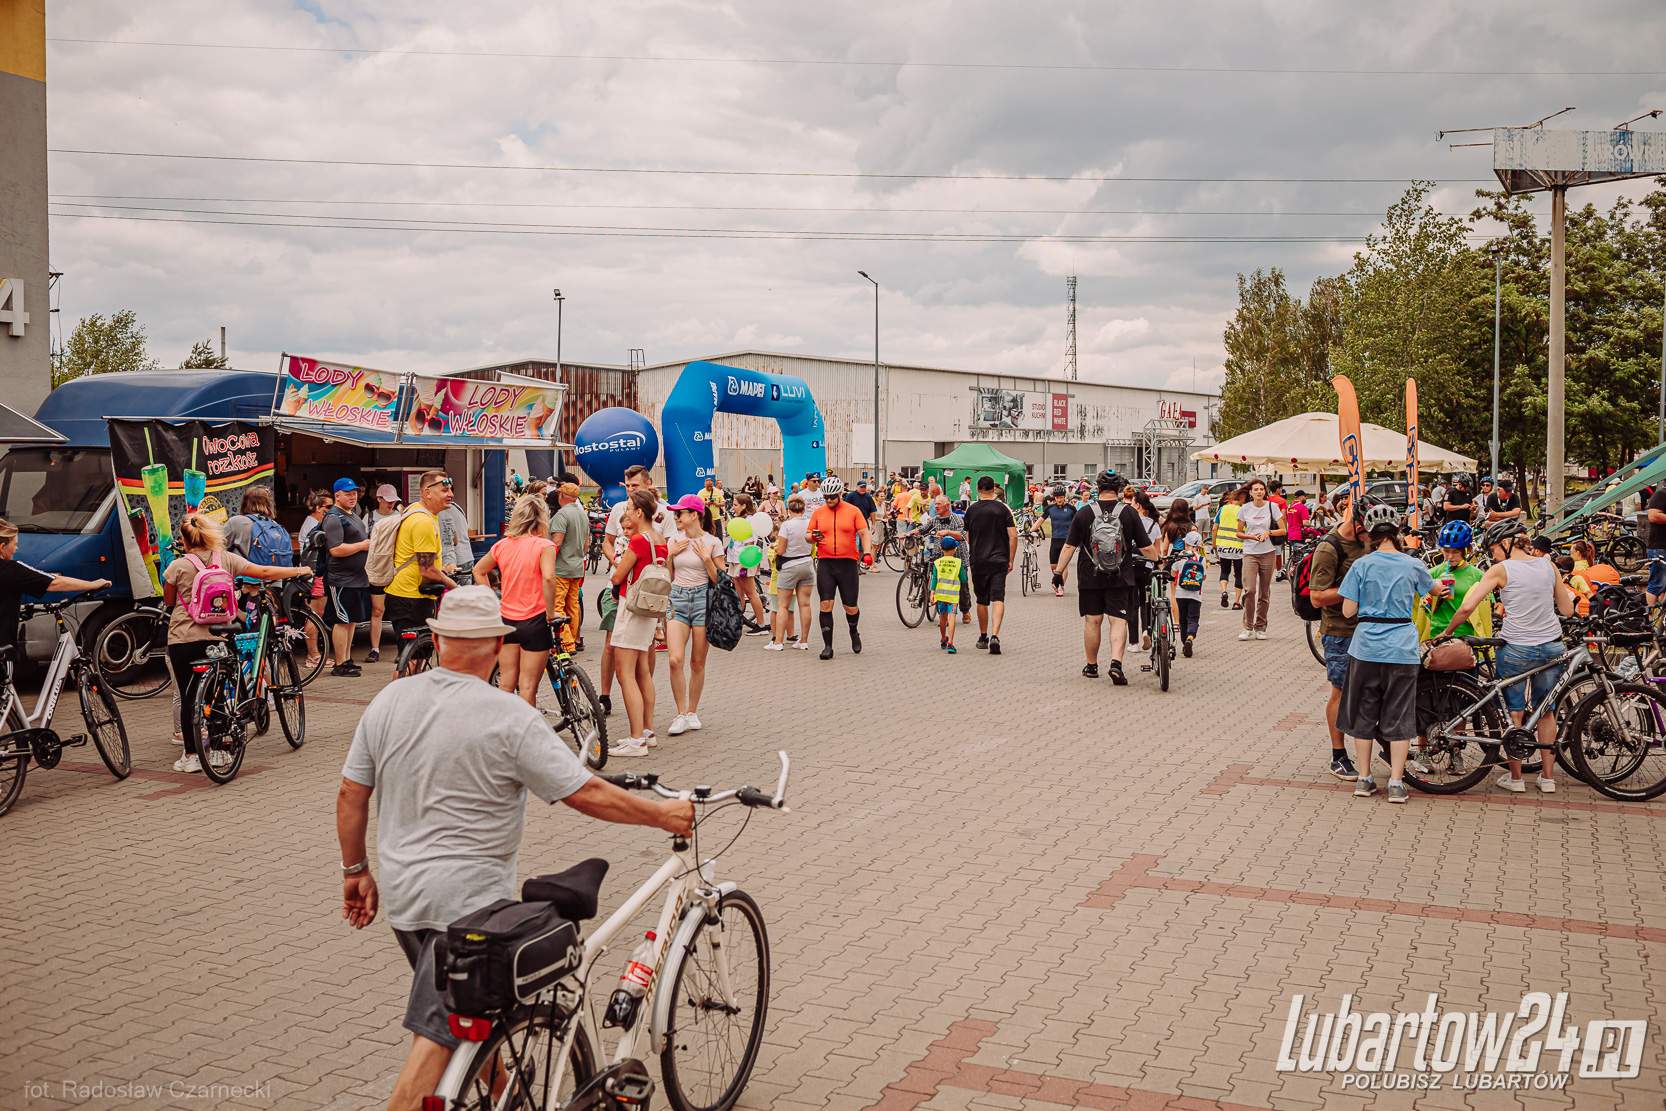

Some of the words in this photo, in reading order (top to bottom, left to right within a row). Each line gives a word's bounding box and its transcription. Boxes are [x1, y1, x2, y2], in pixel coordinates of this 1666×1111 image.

[0, 278, 30, 336] 4
[300, 363, 363, 390] LODY
[467, 383, 528, 411] LODY
[307, 398, 392, 427] WŁOSKIE
[448, 408, 528, 437] WŁOSKIE
